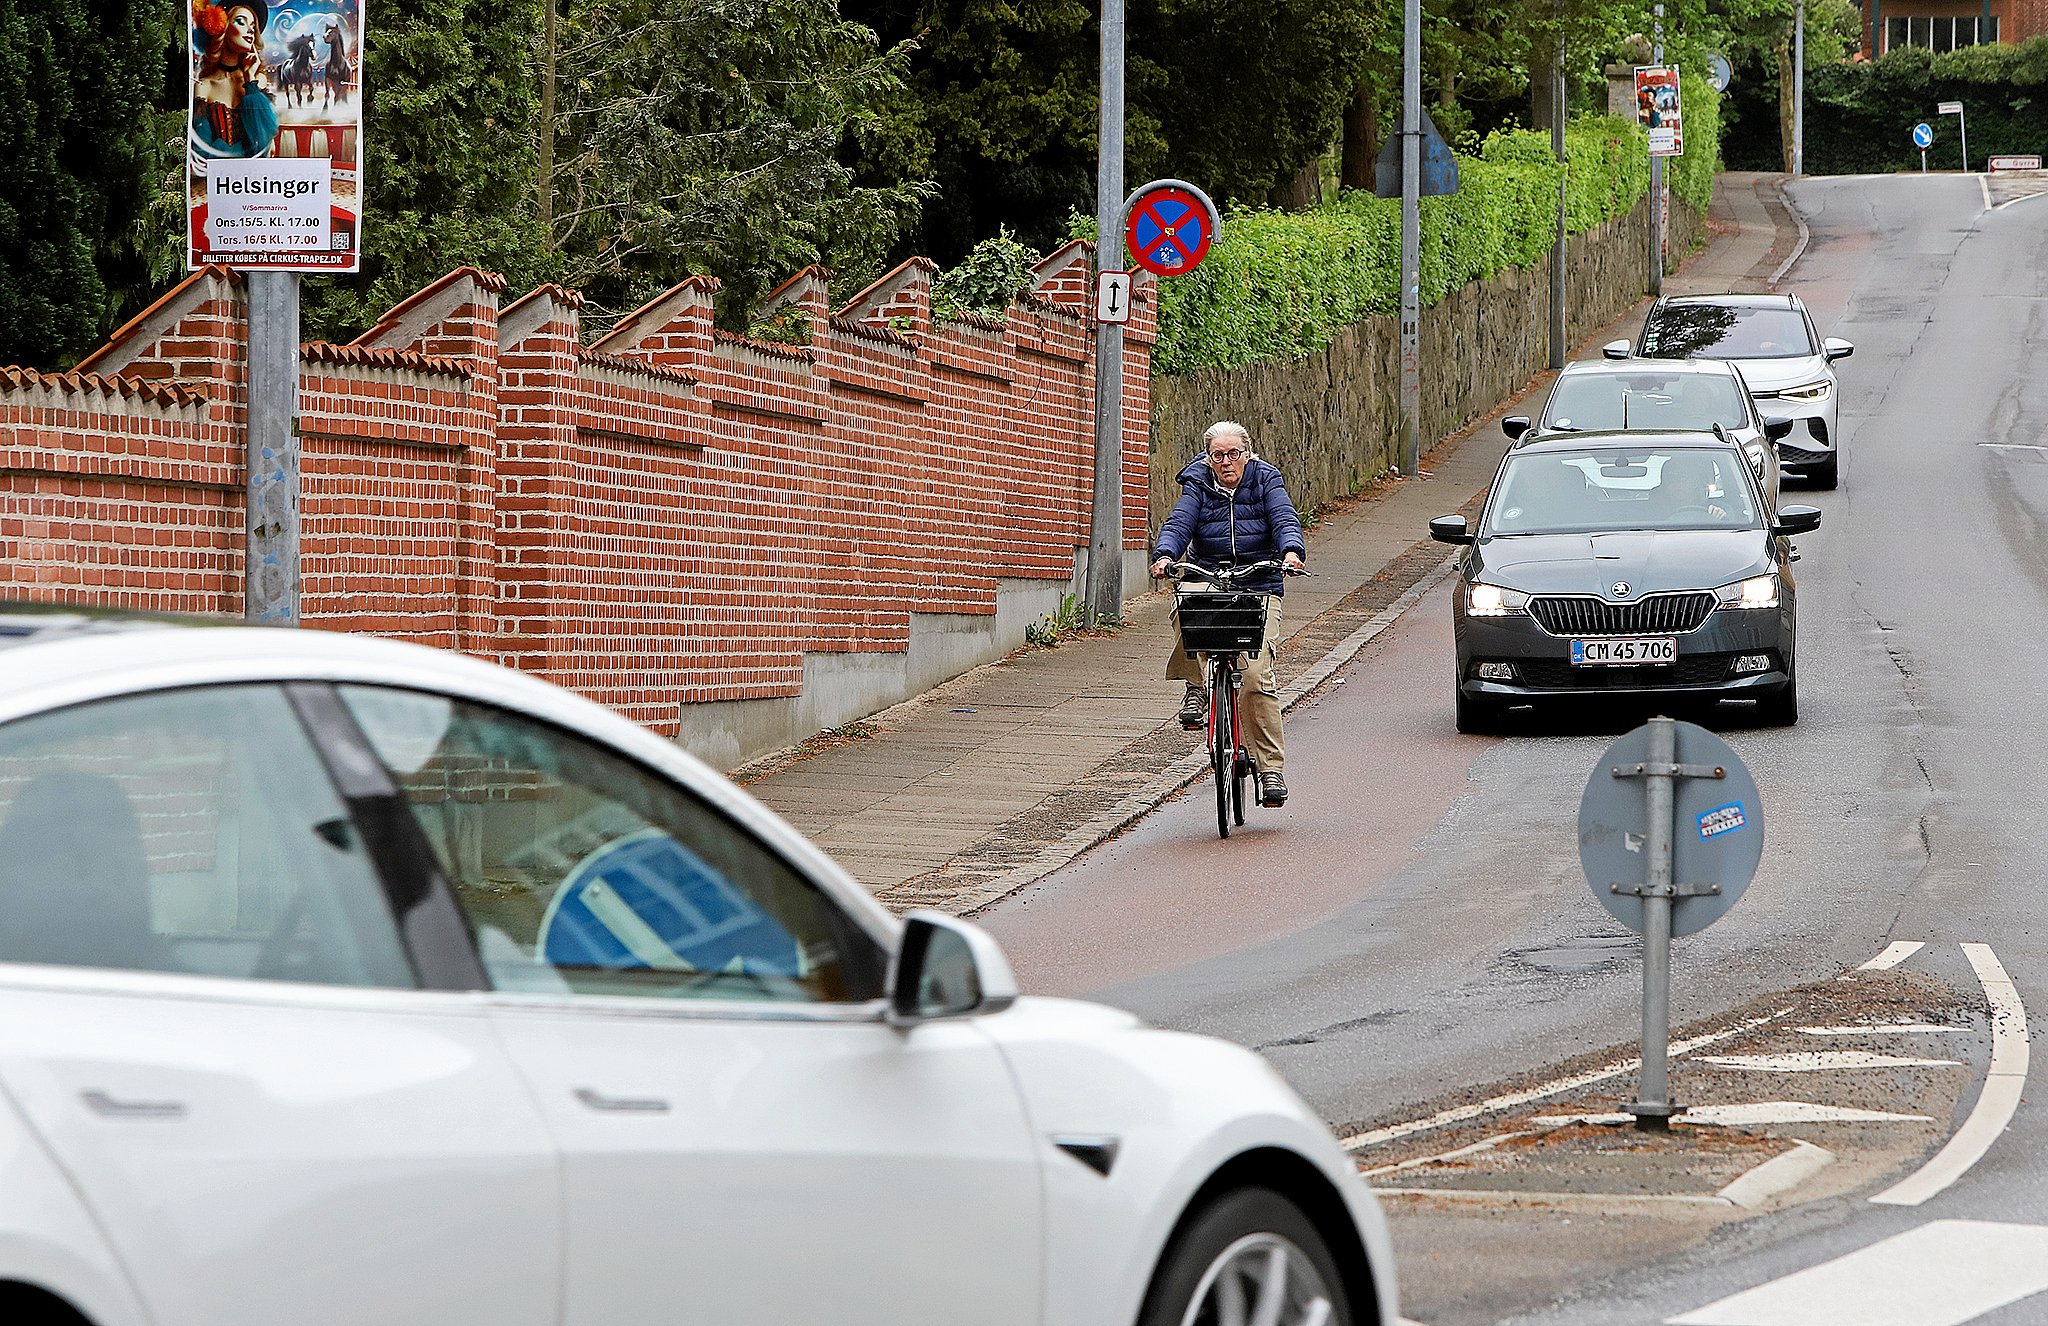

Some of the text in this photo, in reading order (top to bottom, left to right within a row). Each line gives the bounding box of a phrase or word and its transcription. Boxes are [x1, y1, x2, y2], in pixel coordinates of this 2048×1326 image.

[216, 176, 319, 199] Helsingør
[242, 204, 288, 212] V/Sommariva
[269, 217, 285, 227] Kl.
[288, 217, 320, 227] 17.00
[218, 235, 318, 245] Tors. 16/5 Kl. 17.00
[202, 252, 343, 264] BILLETTER KØBES PÅ CIRKUS-TRAPEZ.DK
[1585, 643, 1609, 660] CM
[1613, 642, 1635, 659] 45
[1639, 641, 1673, 659] 706
